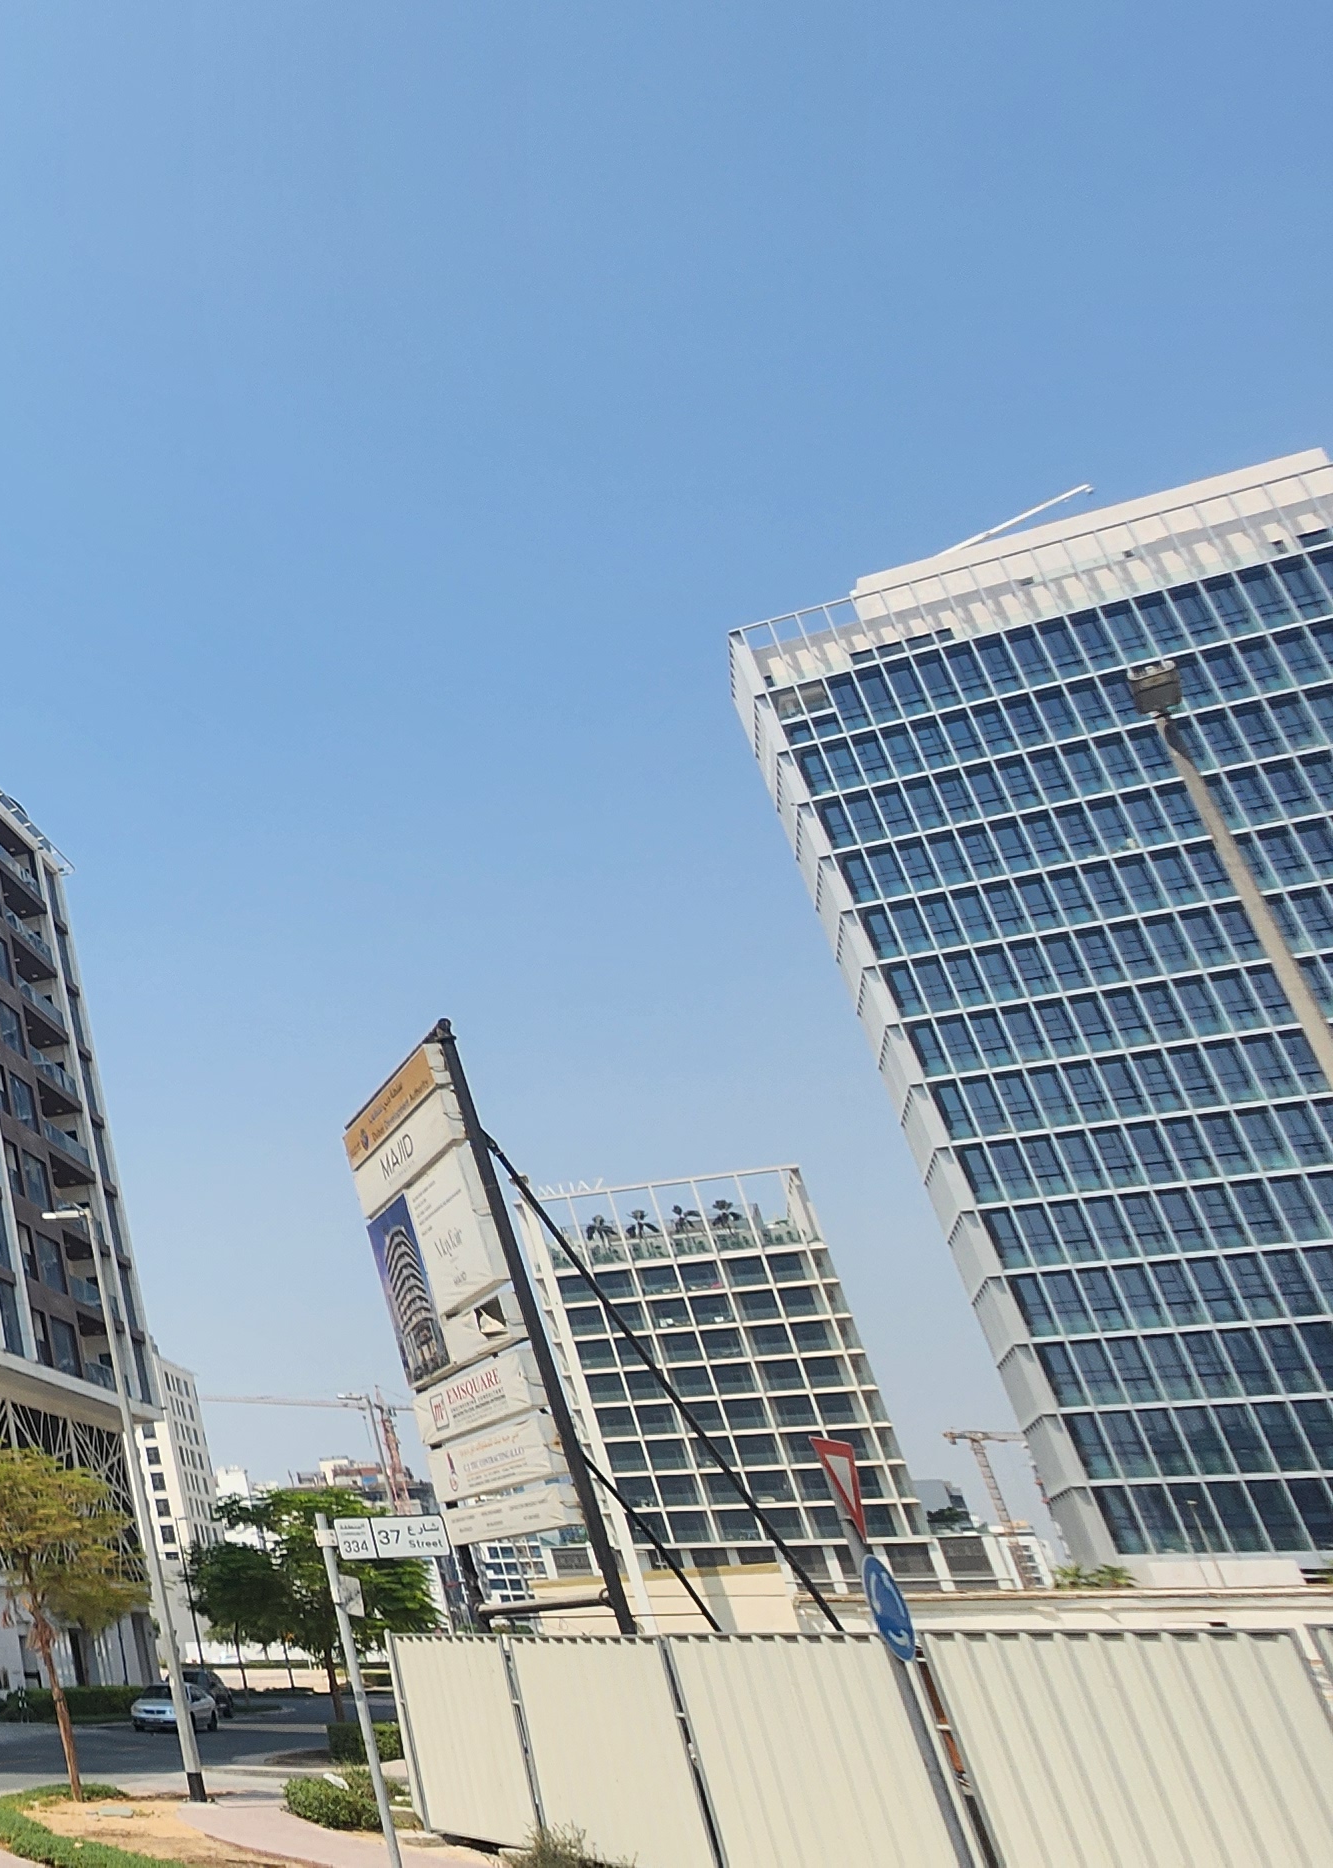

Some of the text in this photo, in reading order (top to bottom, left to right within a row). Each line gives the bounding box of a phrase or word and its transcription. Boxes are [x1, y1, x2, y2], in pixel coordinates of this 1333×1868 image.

[379, 1133, 414, 1181] MAJID
[446, 1367, 502, 1405] EMSQUARE
[407, 1522, 440, 1536] شارع
[377, 1529, 401, 1545] 37
[408, 1538, 443, 1549] Street
[343, 1540, 369, 1553] 334
